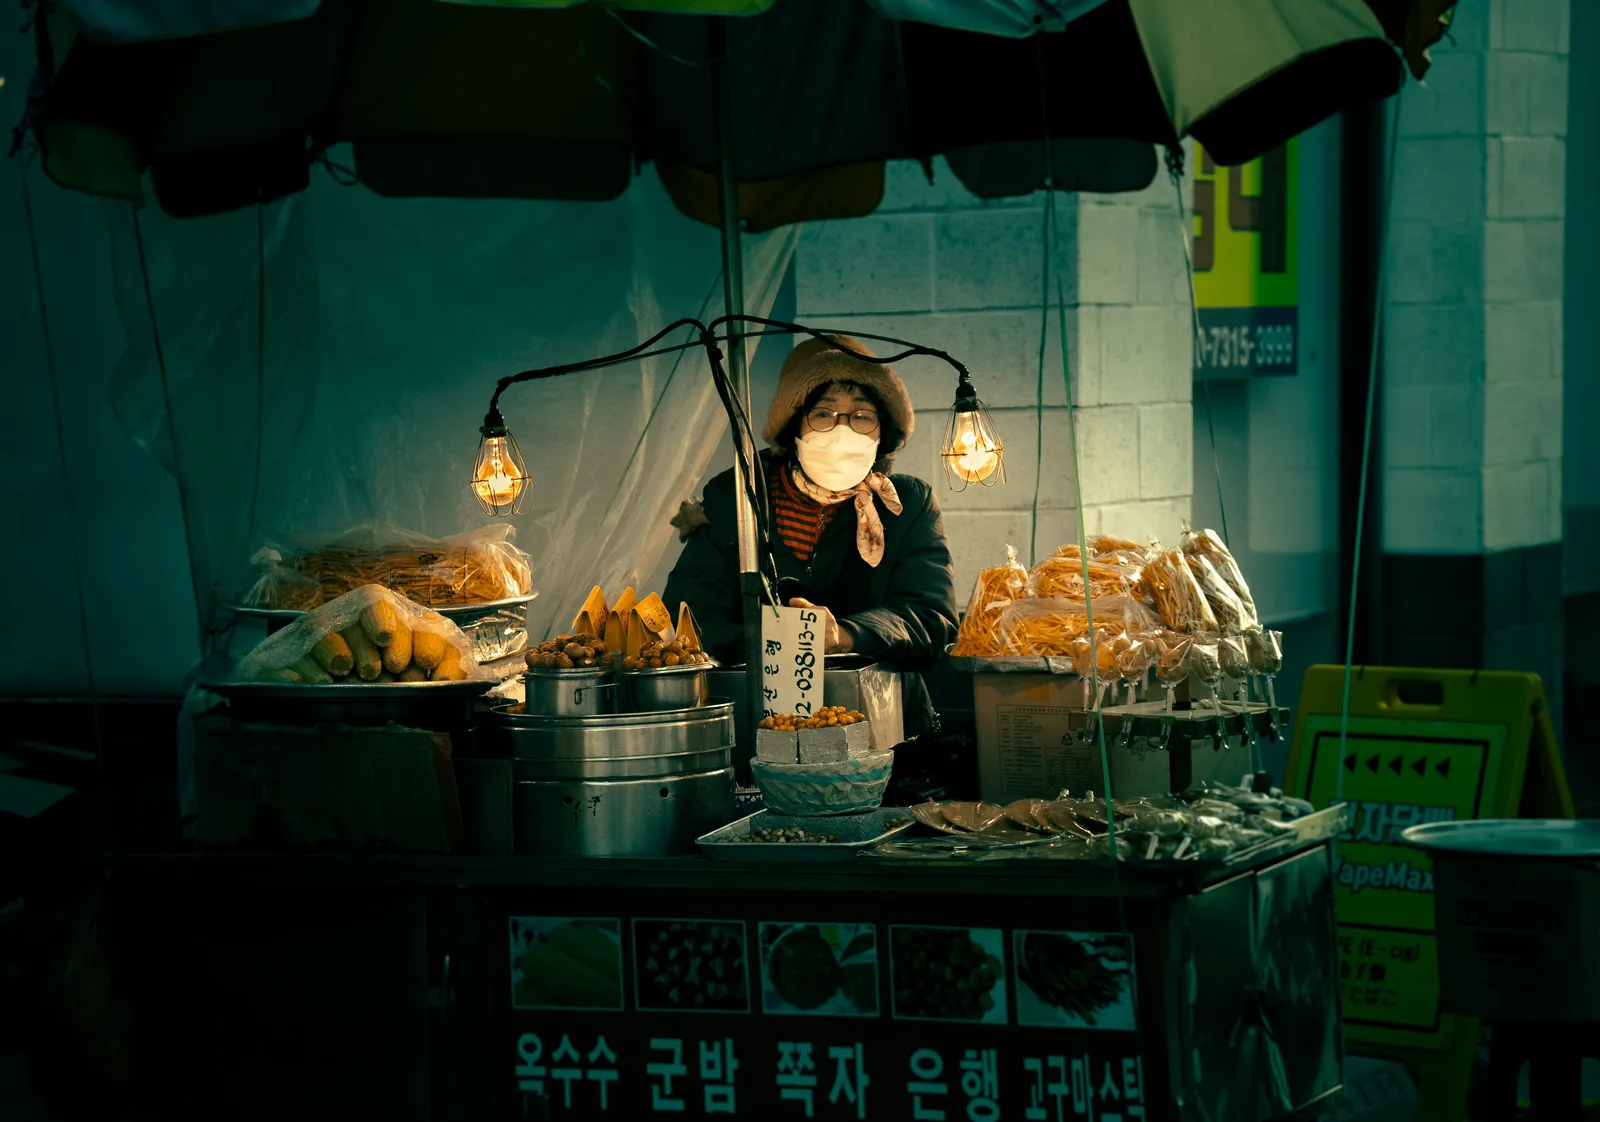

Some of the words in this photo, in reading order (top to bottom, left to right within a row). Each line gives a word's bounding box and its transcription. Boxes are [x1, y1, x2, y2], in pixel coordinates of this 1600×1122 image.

[514, 1031, 620, 1110] 옥수수
[645, 1036, 739, 1114] 군밤
[775, 1040, 870, 1120] 쪽자
[906, 1047, 1001, 1122] 은행
